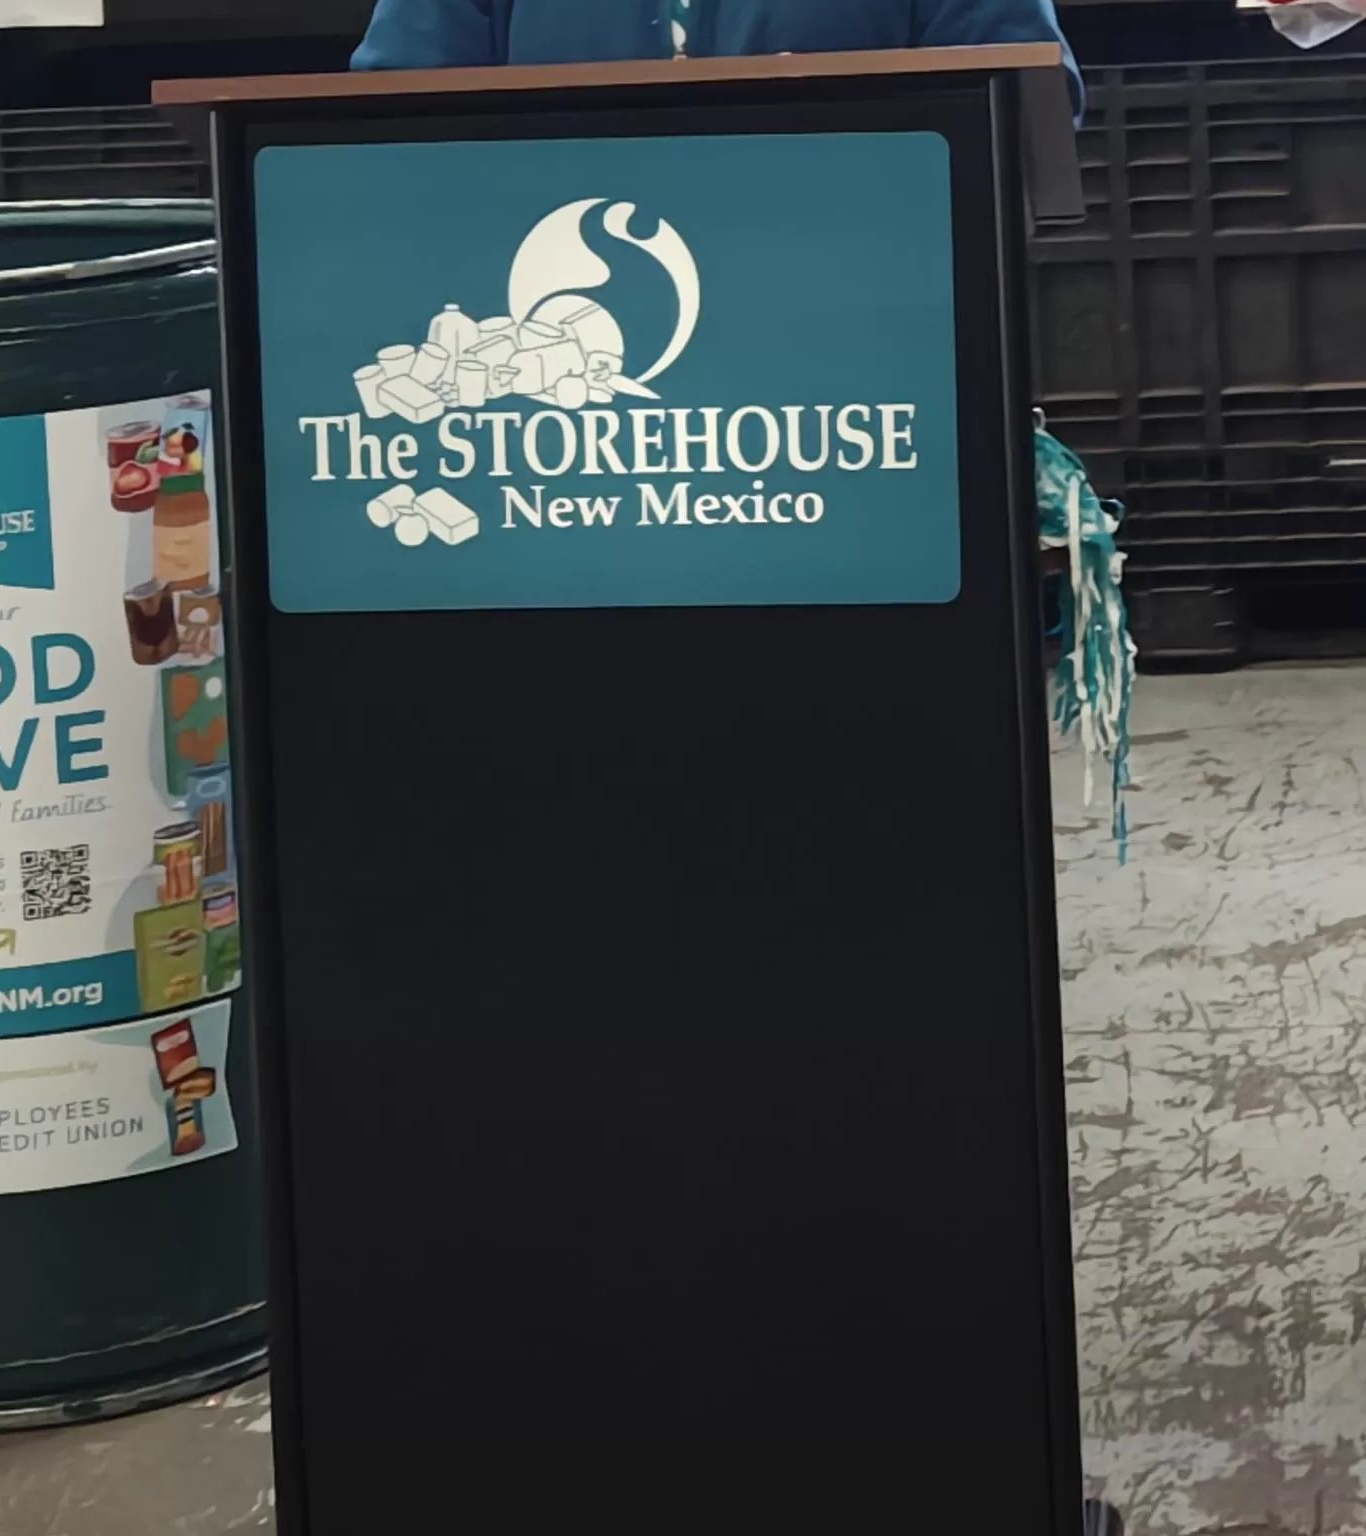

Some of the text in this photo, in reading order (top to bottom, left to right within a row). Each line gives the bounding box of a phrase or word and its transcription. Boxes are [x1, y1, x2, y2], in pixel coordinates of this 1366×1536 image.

[299, 404, 918, 481] The STOREHOUSE
[500, 479, 825, 529] New Mexico
[67, 1114, 144, 1145] UNION
